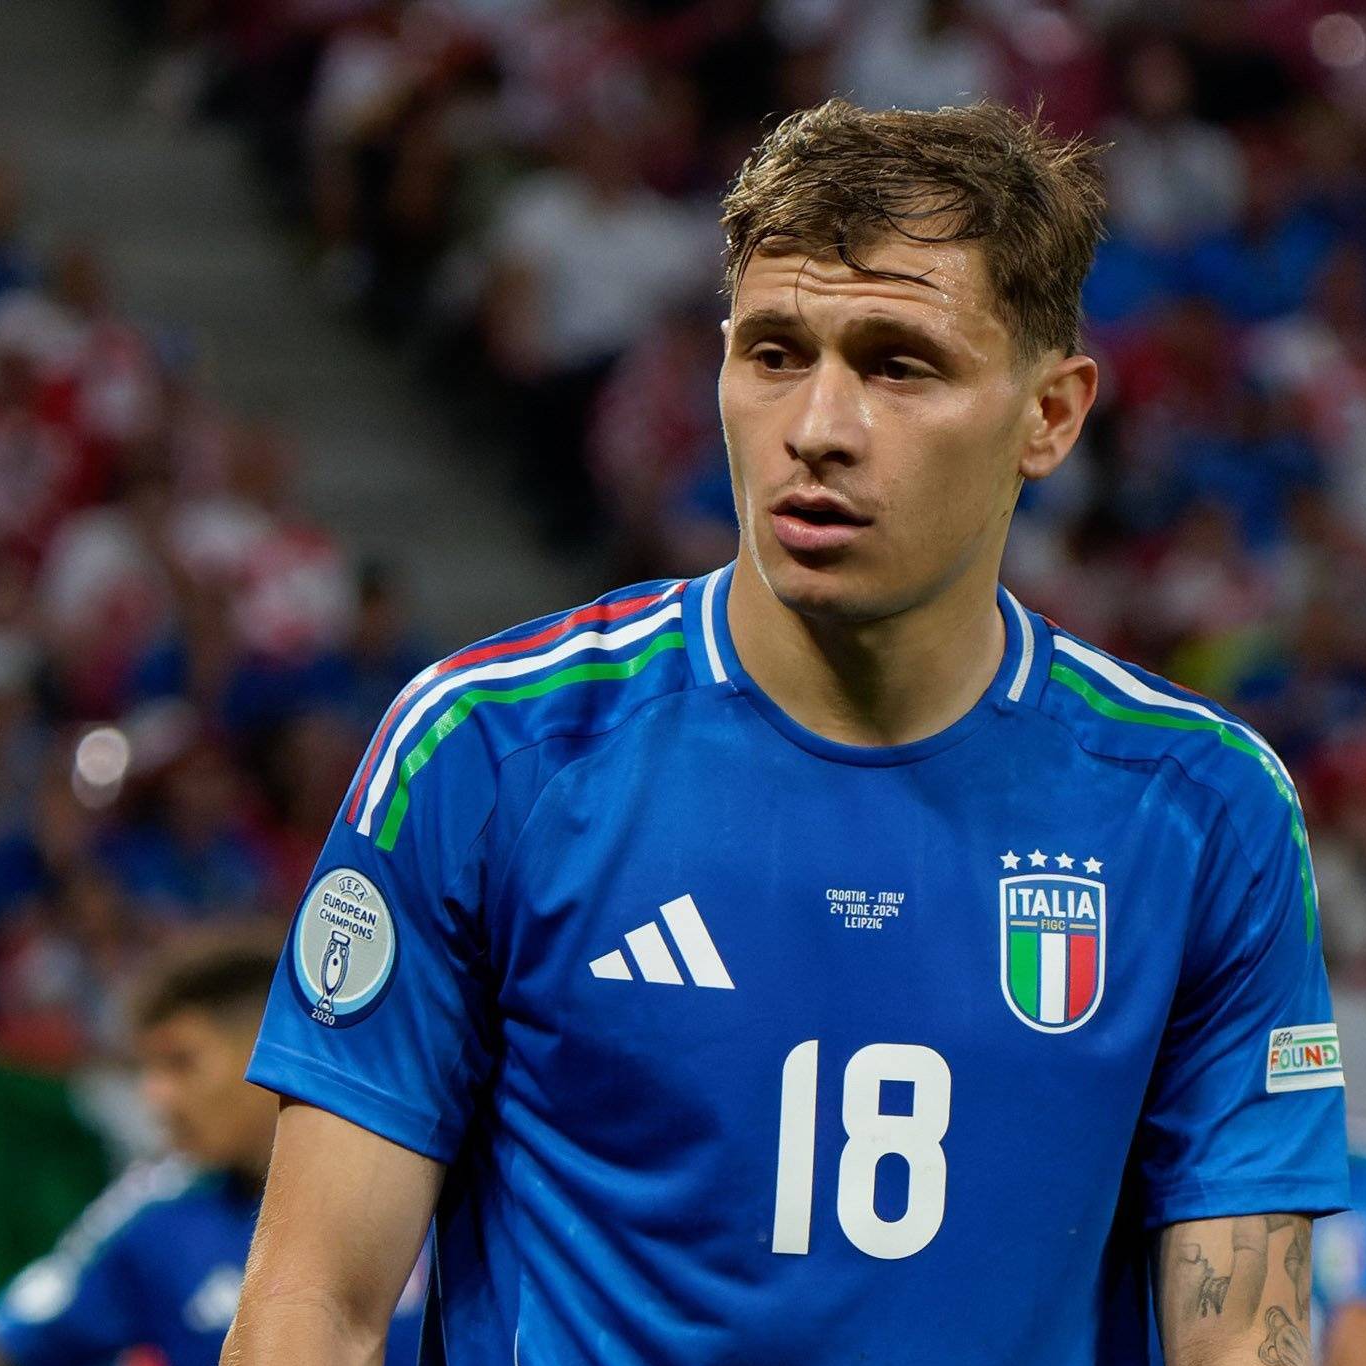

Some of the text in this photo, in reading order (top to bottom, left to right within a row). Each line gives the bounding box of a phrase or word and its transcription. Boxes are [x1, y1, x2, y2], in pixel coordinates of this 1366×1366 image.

[338, 879, 366, 901] UEFA
[825, 888, 867, 903] CROATIA
[878, 891, 905, 904] ITALY
[322, 892, 377, 926] EUROPEAN
[829, 902, 844, 915] 24
[872, 904, 899, 918] 2024
[1008, 887, 1097, 919] ITALIA
[319, 908, 374, 940] CHAMPIONS
[844, 917, 883, 930] LEIPZIG
[1040, 918, 1066, 931] FIGC
[311, 1006, 336, 1026] 2020
[772, 1039, 952, 1260] 18
